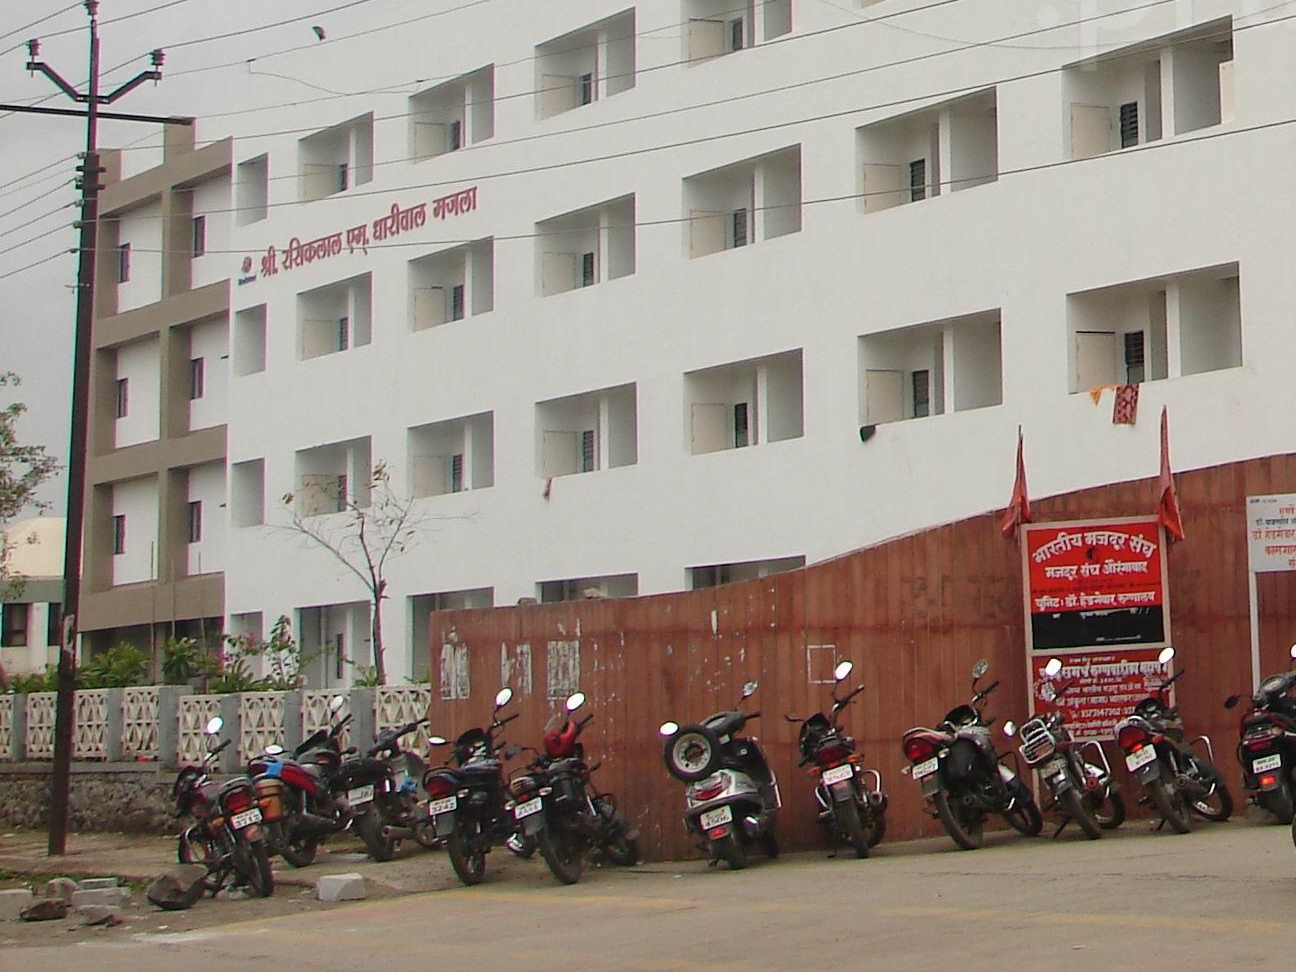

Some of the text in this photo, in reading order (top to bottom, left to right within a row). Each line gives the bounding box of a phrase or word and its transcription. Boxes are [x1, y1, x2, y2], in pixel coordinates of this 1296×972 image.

[373, 202, 427, 242] धारीवाल
[433, 185, 478, 221] मजला
[1032, 530, 1158, 563] भारतीय मजदूर संघ
[1045, 565, 1078, 581] मजदूर
[1080, 562, 1100, 578] संघ
